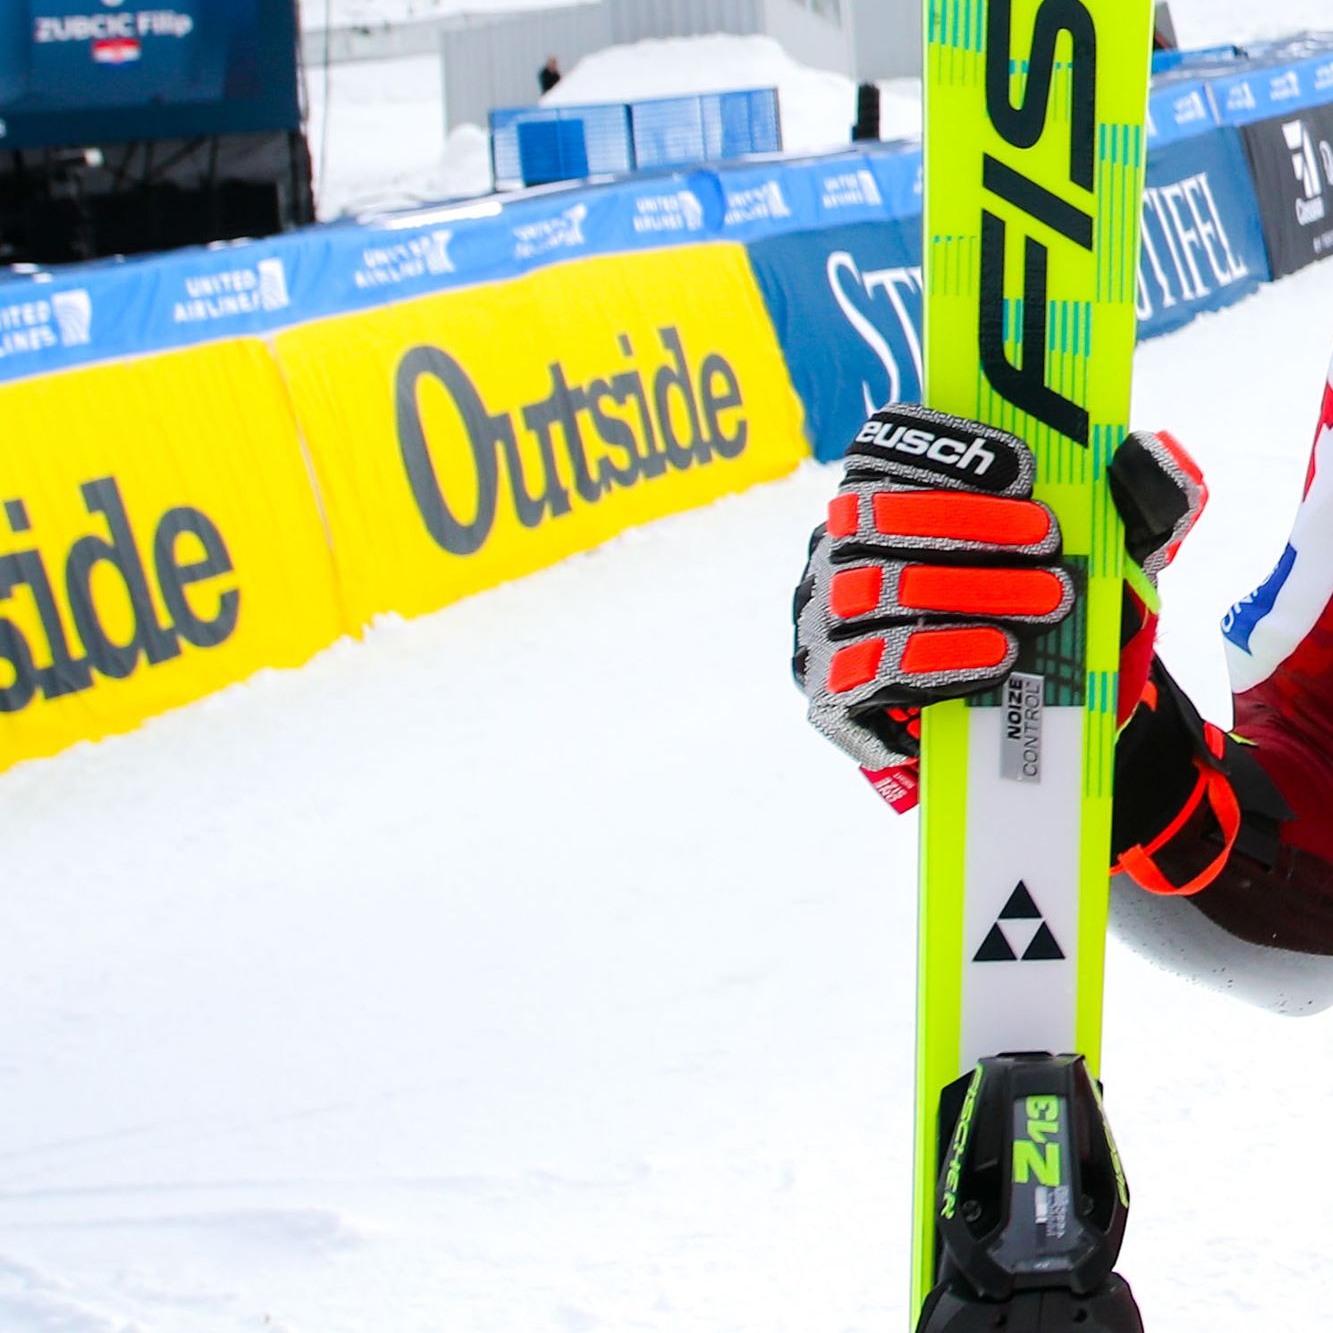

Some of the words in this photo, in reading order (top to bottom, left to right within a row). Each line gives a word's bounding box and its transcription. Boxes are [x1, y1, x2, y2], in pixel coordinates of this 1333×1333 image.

[136, 9, 194, 38] Filip
[1137, 172, 1248, 322] TIFEL
[185, 269, 258, 298] UNITED
[395, 326, 748, 557] Outside
[855, 420, 996, 476] eusch
[1007, 678, 1024, 740] NOIZE
[940, 1062, 985, 1220] FISCHER
